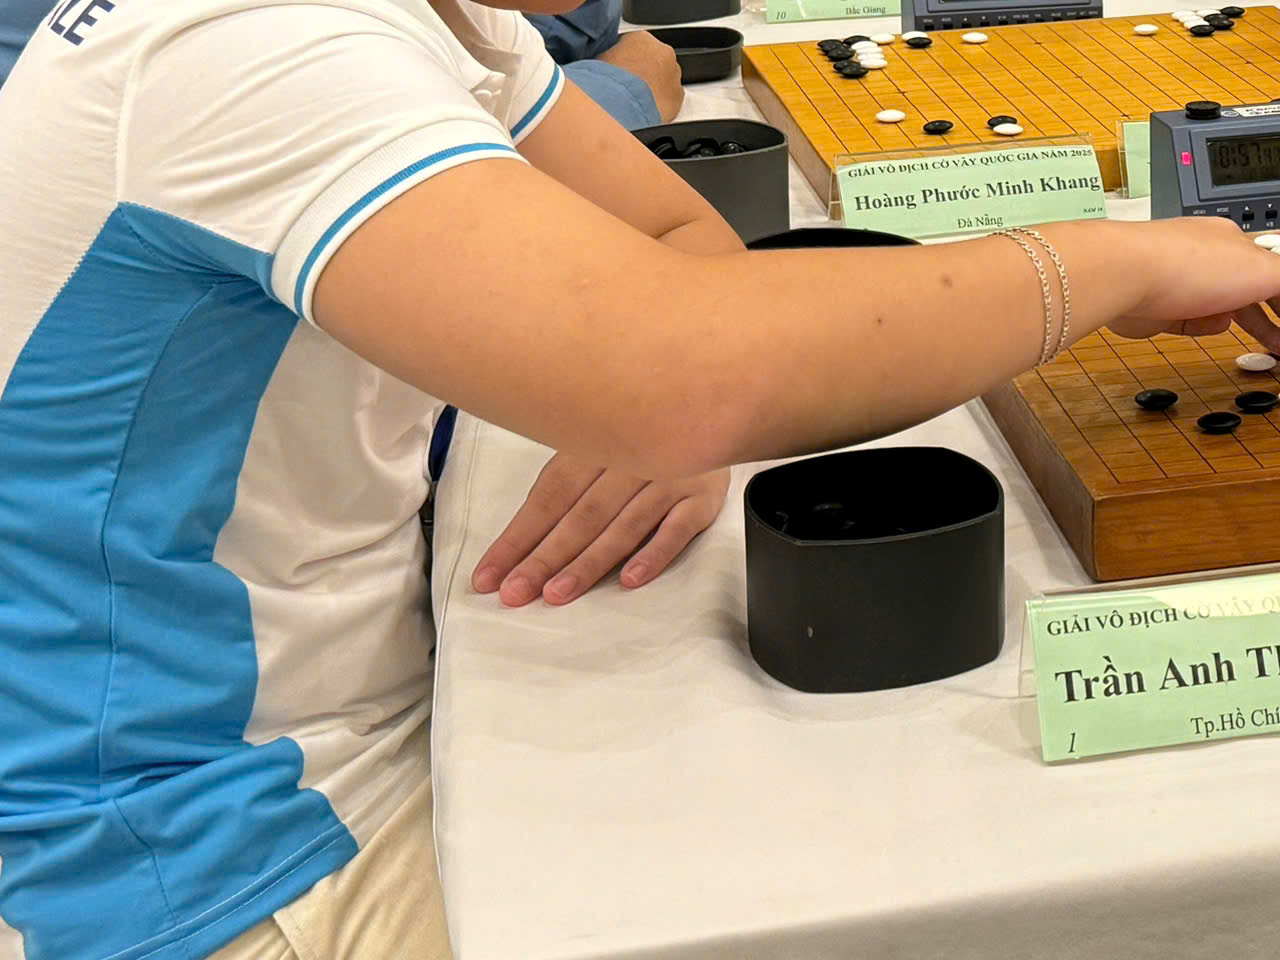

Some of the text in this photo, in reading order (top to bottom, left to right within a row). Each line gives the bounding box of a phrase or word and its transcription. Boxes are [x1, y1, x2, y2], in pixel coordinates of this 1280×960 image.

[776, 10, 786, 20] 10
[848, 148, 1093, 178] GIẢI VÔ ĐỊCH CỜ VÂY QUỐC GIA NĂM 2025
[854, 174, 1100, 212] Hoàng Phước Minh Khang
[957, 213, 1004, 229] Đà Nẵng
[1046, 614, 1091, 636] GIẢI
[1096, 610, 1124, 629] VÔ
[1130, 608, 1178, 628] ĐỊCH
[1054, 655, 1147, 704] Trần
[1159, 652, 1237, 690] Anh
[1190, 707, 1246, 738] Tp.Hồ
[1250, 706, 1280, 727] Chí
[1067, 732, 1077, 754] 1
